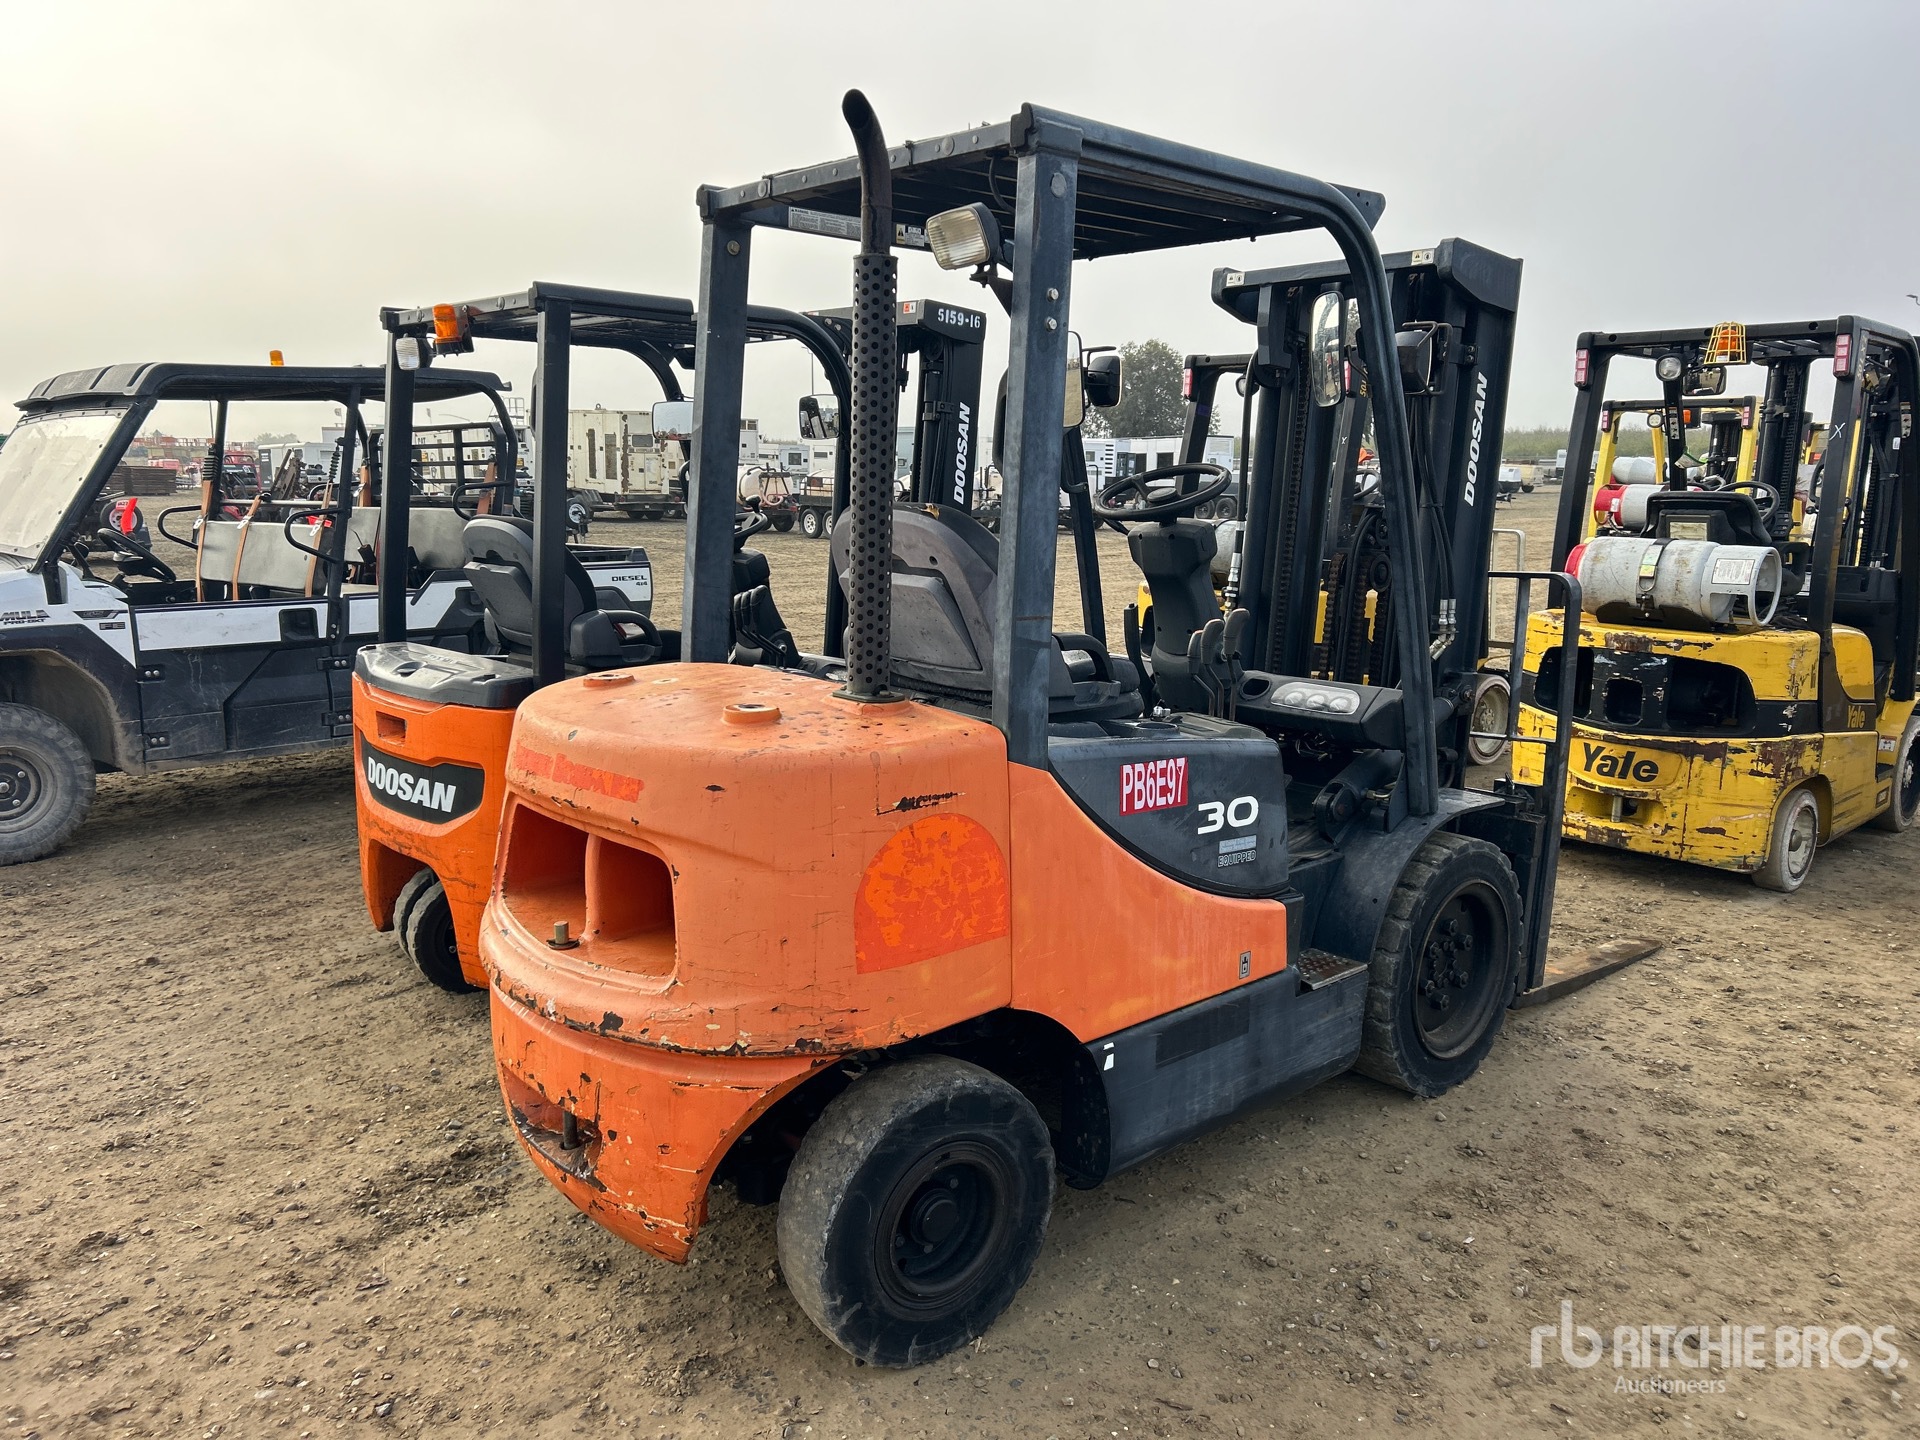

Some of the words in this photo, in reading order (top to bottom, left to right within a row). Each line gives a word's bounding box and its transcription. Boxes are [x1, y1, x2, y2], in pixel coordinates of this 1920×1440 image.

[953, 401, 971, 505] DOOSAN
[1464, 371, 1488, 507] DOOSAN
[1847, 704, 1866, 729] Yale
[368, 756, 457, 813] DOOSAN
[1122, 757, 1186, 813] PB6E97
[1583, 742, 1659, 783] Yale
[1197, 795, 1259, 835] 30
[1217, 849, 1257, 868] EQUIPPED
